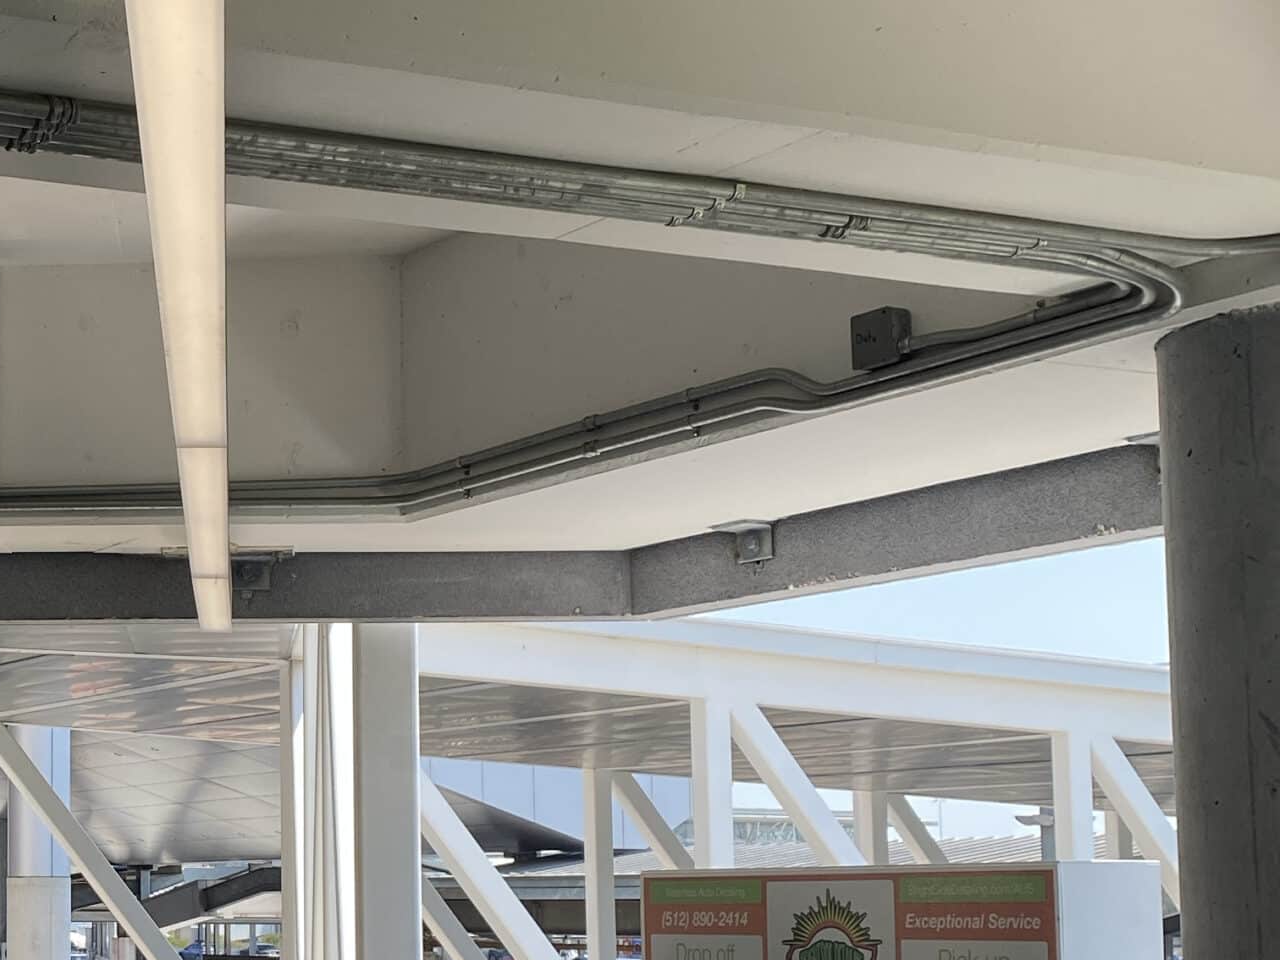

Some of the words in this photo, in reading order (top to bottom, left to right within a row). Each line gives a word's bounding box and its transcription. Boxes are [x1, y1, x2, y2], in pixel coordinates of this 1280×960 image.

[662, 911, 689, 929] (512)
[692, 911, 749, 927] 890-2414
[904, 913, 984, 932] Exceptional
[988, 913, 1041, 930] Service
